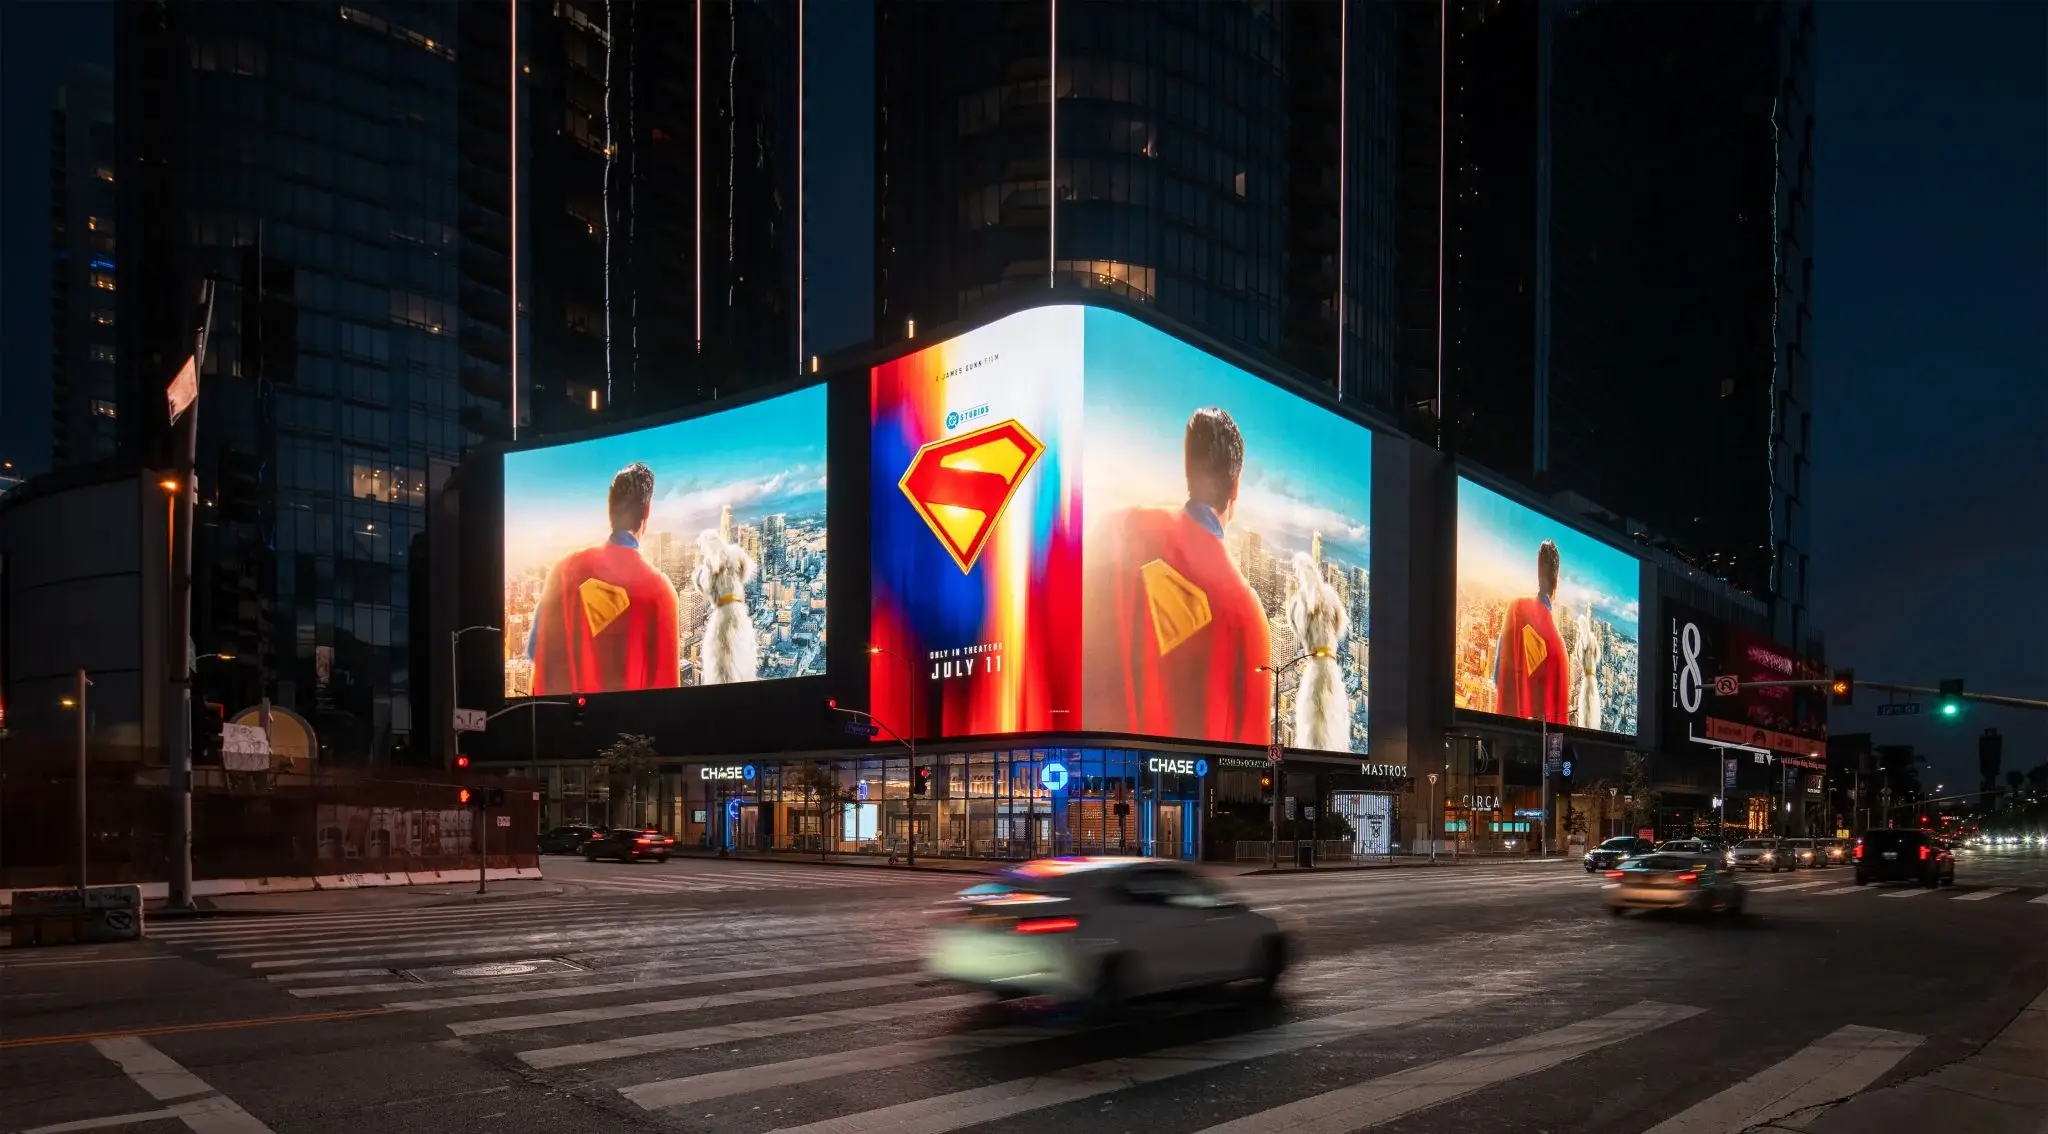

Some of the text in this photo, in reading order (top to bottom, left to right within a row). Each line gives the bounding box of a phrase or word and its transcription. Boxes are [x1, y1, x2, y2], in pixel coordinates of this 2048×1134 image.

[940, 367, 962, 380] JAMES
[984, 353, 999, 364] FILM
[960, 405, 989, 421] STUDIOS
[929, 642, 1002, 660] ONLY IN THEATERS
[931, 655, 1001, 679] JULY 11
[1680, 622, 1702, 713] 8
[701, 766, 743, 780] CHASE
[1149, 757, 1194, 774] CHASE
[1361, 762, 1407, 777] MASTRO'S
[1462, 794, 1500, 809] CIRCA
